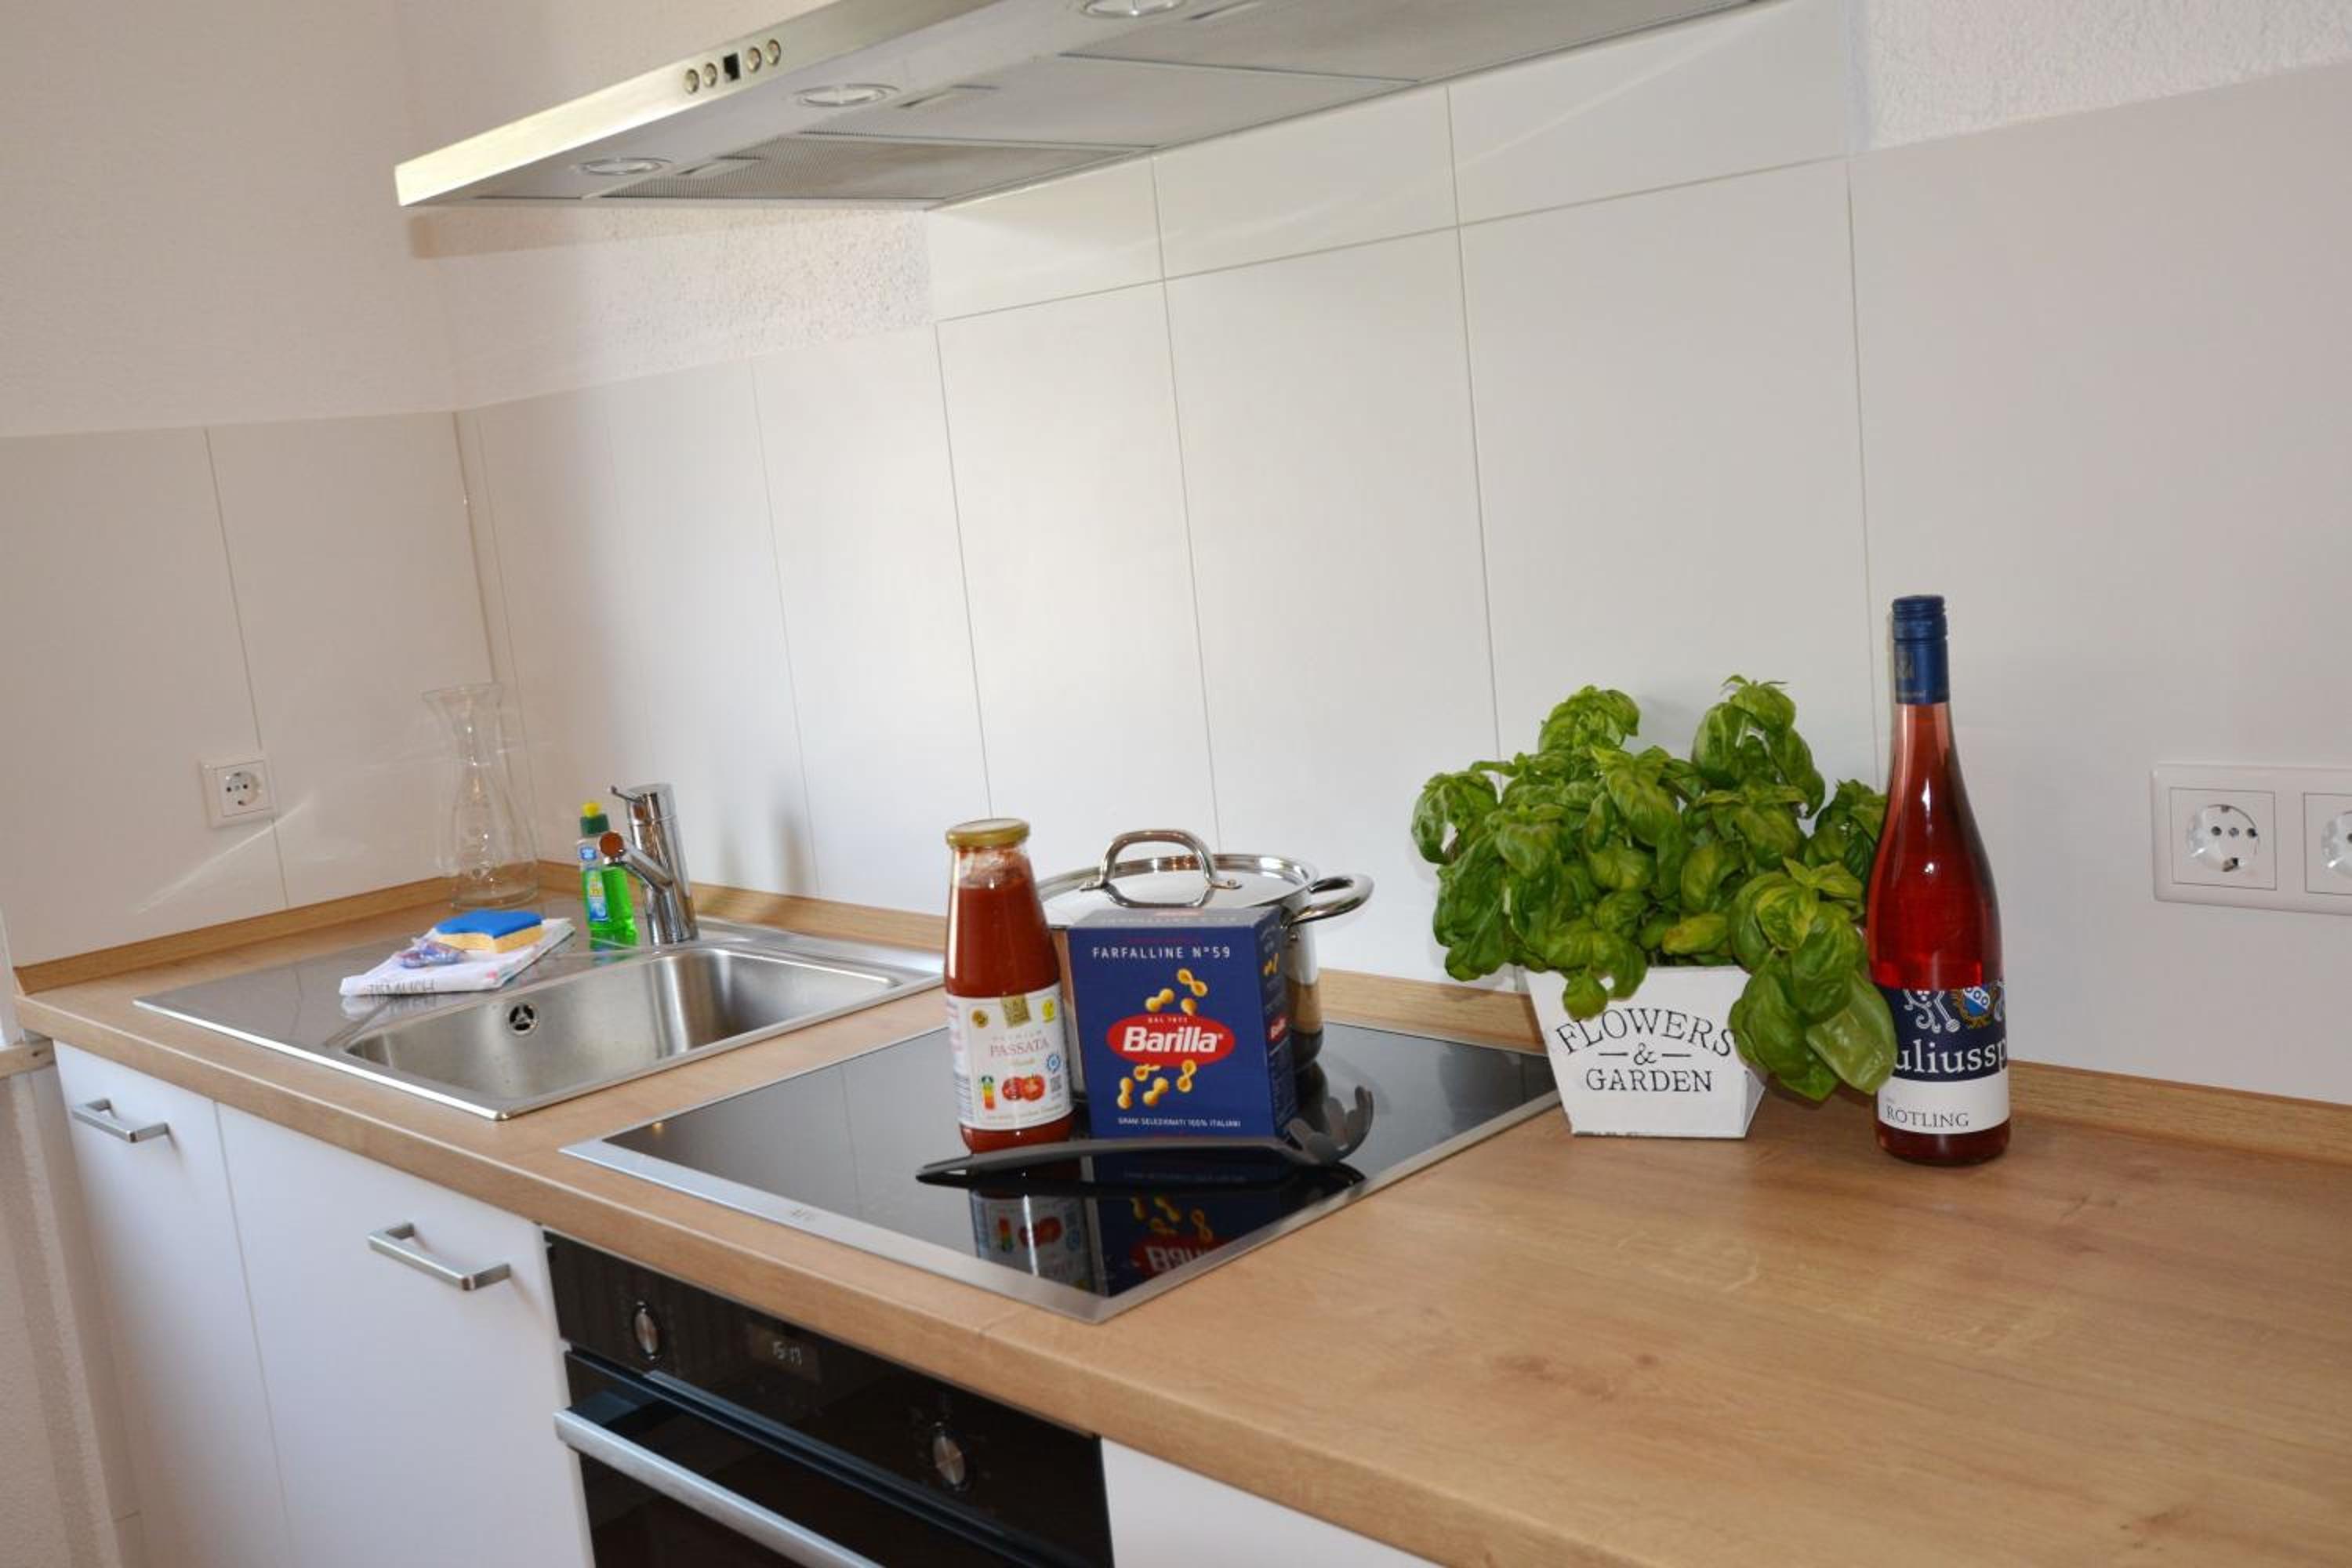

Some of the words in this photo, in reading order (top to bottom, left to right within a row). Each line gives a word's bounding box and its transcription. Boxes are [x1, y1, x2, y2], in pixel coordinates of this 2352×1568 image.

[1092, 946, 1184, 959] FARFALLINE
[1123, 1026, 1218, 1054] Barilla
[1555, 1007, 1734, 1057] FLOWERS
[990, 1038, 1051, 1057] PASSATA
[1633, 1042, 1657, 1065] &
[1894, 1039, 2007, 1074] uliussp
[1585, 1069, 1713, 1092] GARDEN
[1886, 1104, 1970, 1128] ROTLING
